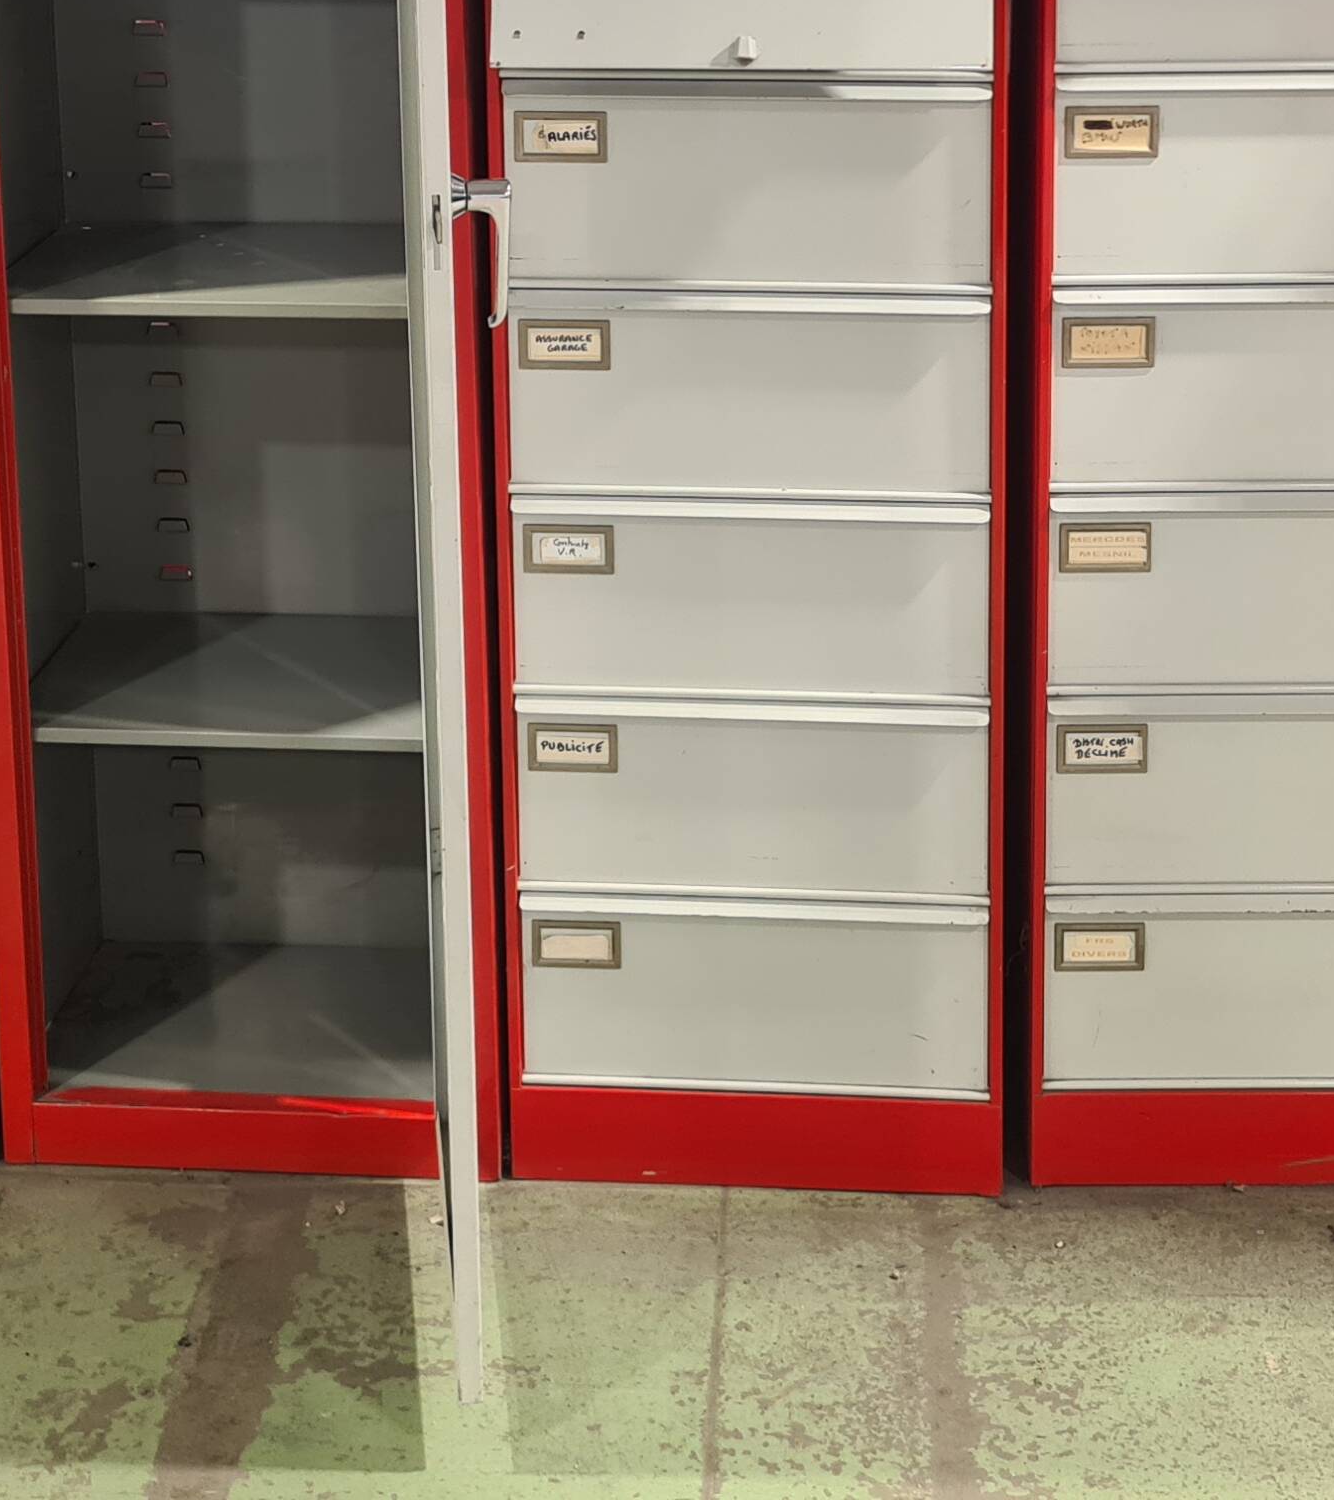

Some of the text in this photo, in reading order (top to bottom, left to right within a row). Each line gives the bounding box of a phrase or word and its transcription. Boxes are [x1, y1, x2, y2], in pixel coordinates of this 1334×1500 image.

[535, 333, 594, 344] ASSURANCE
[546, 342, 588, 353] GARAGE
[1108, 737, 1134, 747] CASH
